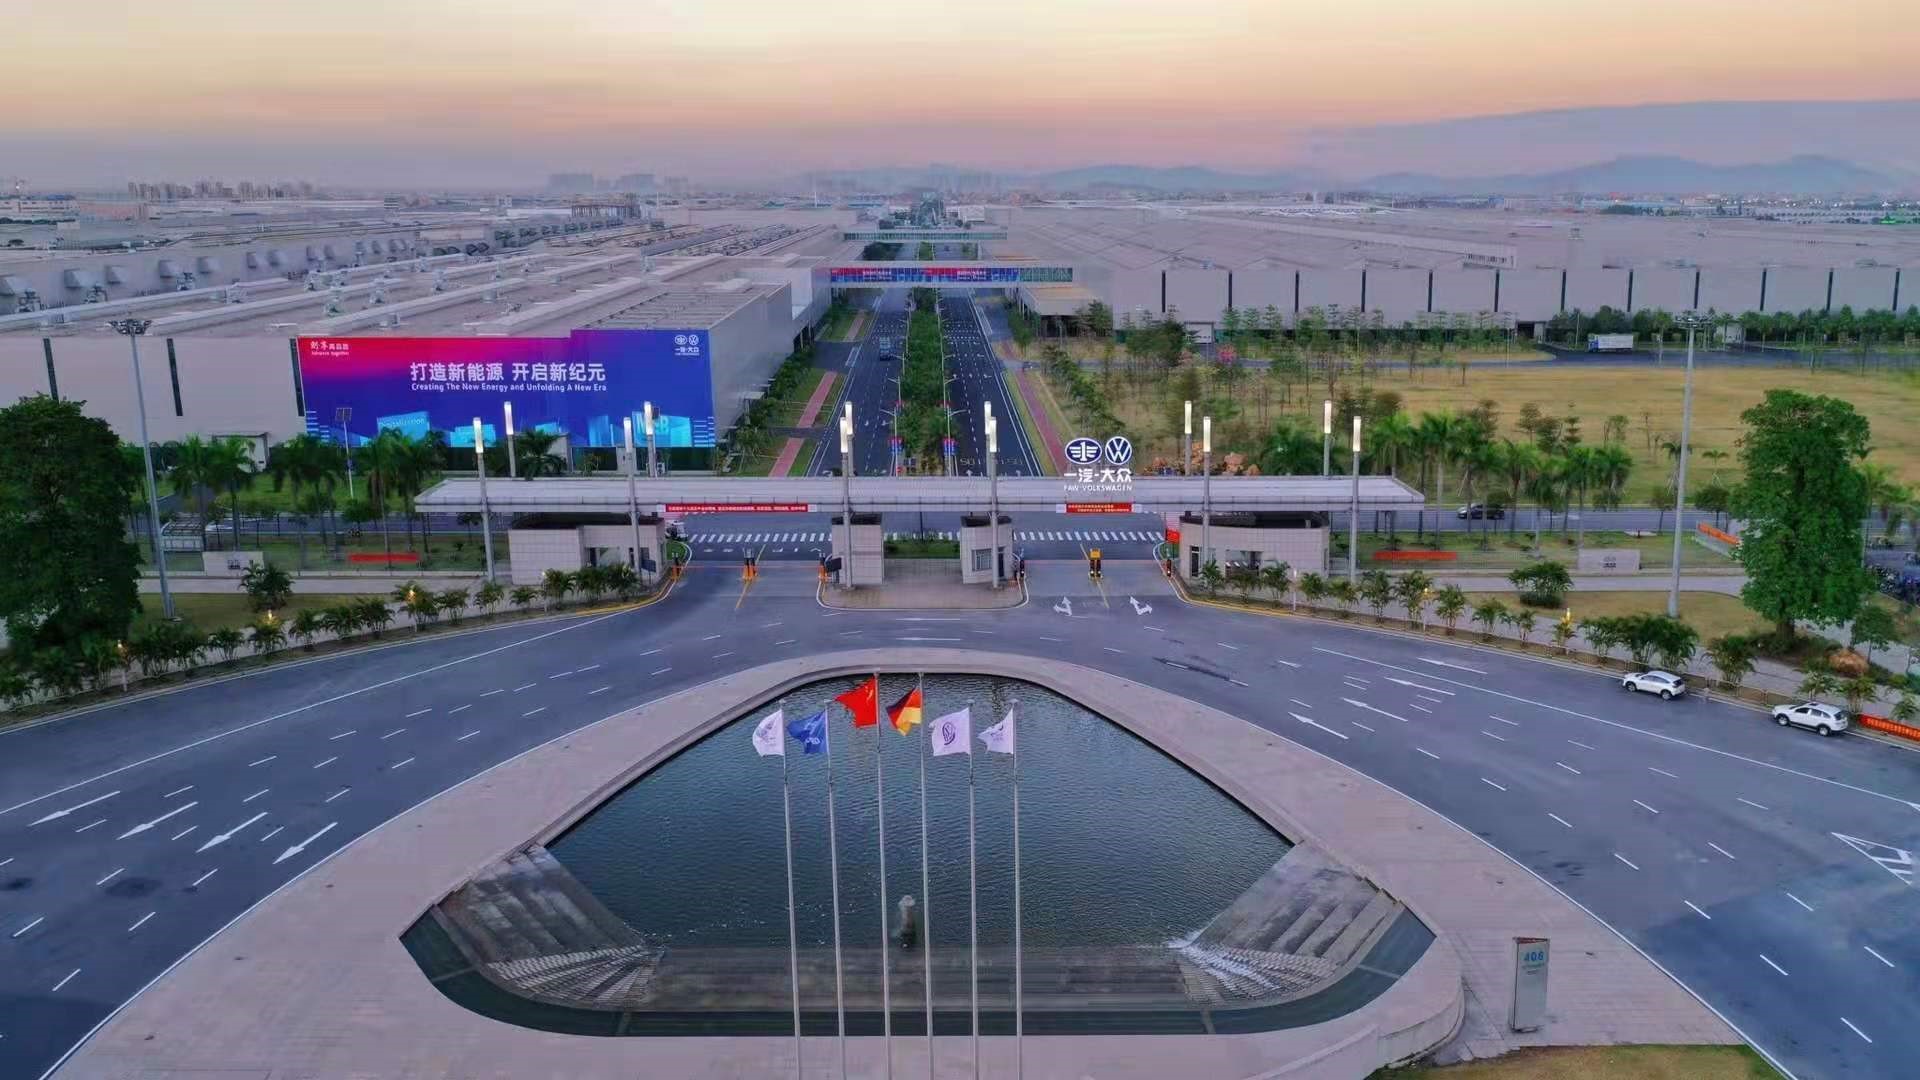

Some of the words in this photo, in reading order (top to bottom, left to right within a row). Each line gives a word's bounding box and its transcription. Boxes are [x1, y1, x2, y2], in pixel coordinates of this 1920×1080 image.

[410, 362, 504, 381] 打造新能源
[512, 362, 606, 381] 开启新纪元
[411, 382, 444, 392] Creating
[446, 382, 460, 391] The
[462, 382, 479, 391] New
[481, 382, 508, 392] Energy
[510, 382, 524, 391] and
[526, 382, 564, 392] Unfolding
[566, 383, 573, 391] A
[574, 383, 591, 391] New
[593, 383, 607, 391] Era
